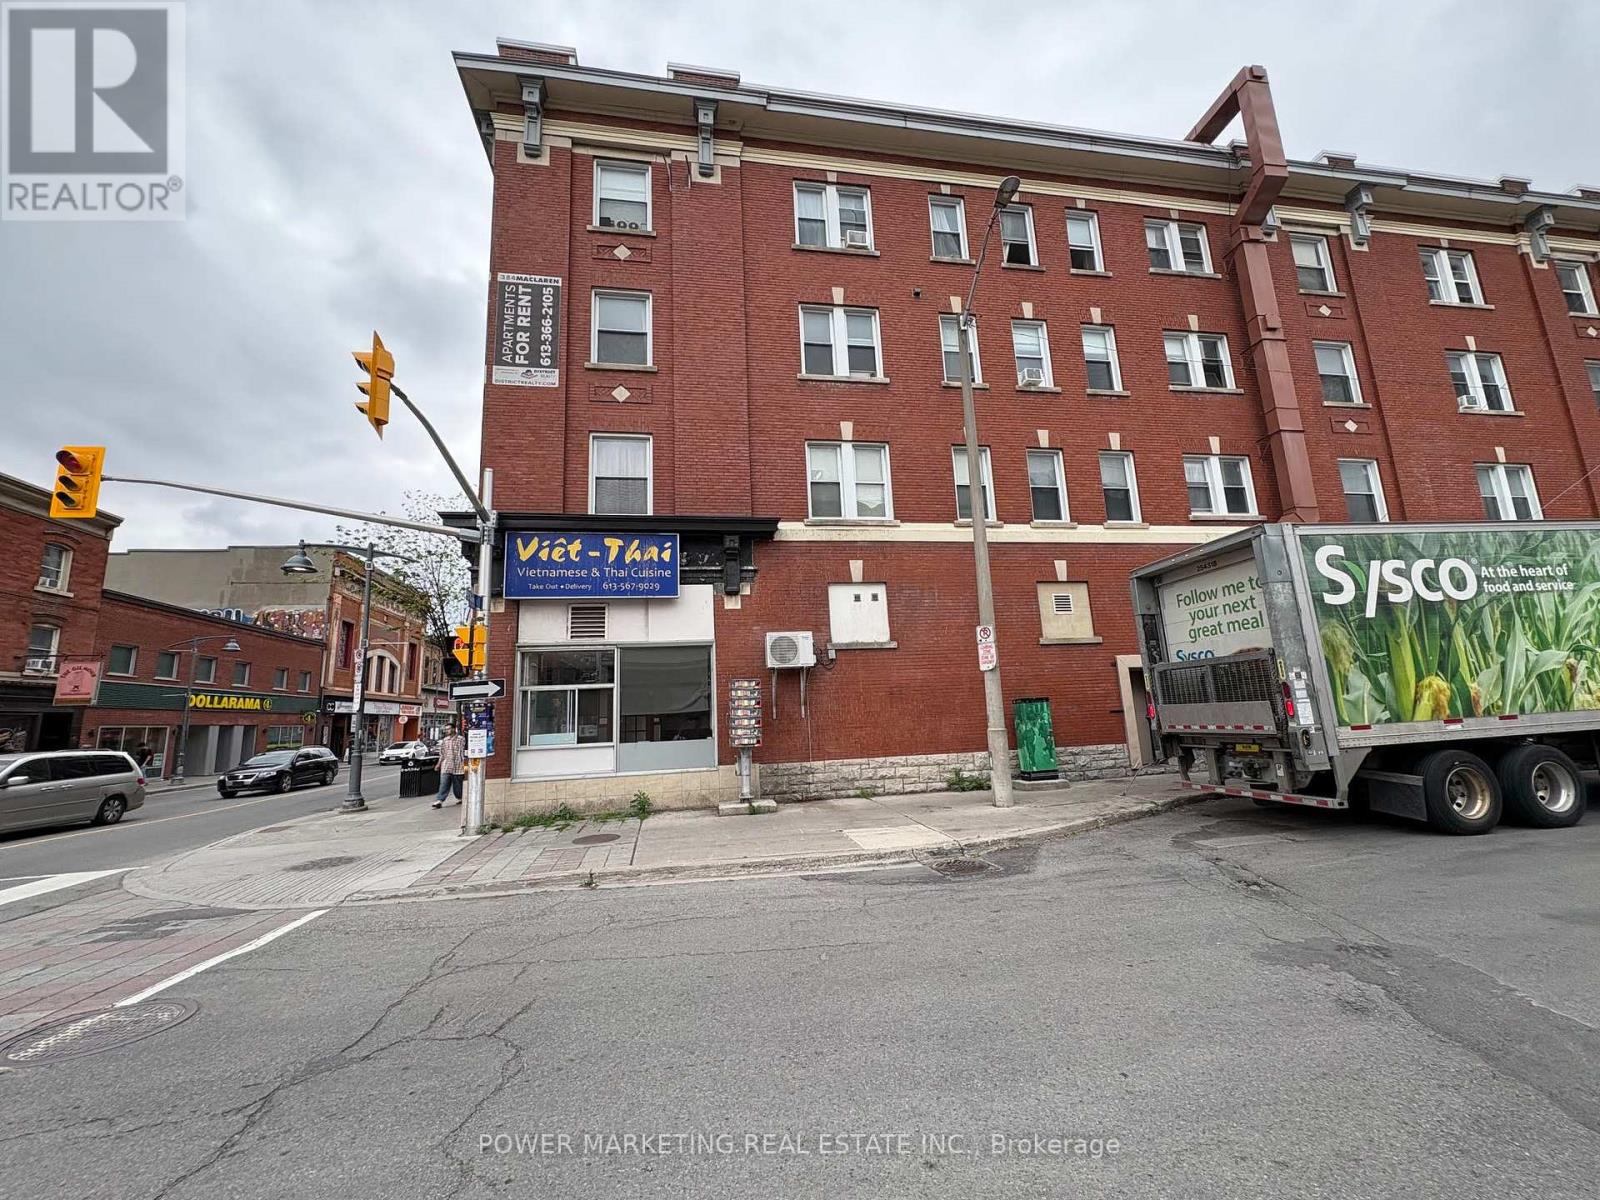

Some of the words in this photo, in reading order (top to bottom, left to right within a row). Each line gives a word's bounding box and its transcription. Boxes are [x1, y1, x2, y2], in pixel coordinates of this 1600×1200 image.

[517, 285, 532, 327] RENT
[502, 284, 516, 363] APARTMENTS
[540, 287, 554, 366] 613-366-2105
[515, 331, 530, 365] FOR
[604, 537, 672, 564] Thai
[517, 567, 588, 578] Vietnamese
[591, 568, 600, 578] &
[604, 567, 628, 578] Thai
[631, 567, 672, 578] Cuisine
[1481, 566, 1496, 578] At
[1496, 565, 1518, 577] the
[1519, 565, 1555, 577] heart
[1555, 563, 1569, 576] of
[565, 583, 592, 591] Delivery
[602, 583, 660, 591] 613-567-9029
[1175, 587, 1218, 608] Follow
[1222, 580, 1245, 597] me
[1483, 580, 1511, 592] food
[1512, 580, 1533, 591] and
[1535, 579, 1575, 591] service
[1189, 605, 1219, 626] your
[1222, 595, 1257, 615] next
[1188, 620, 1224, 643] great
[1226, 611, 1264, 633] meal
